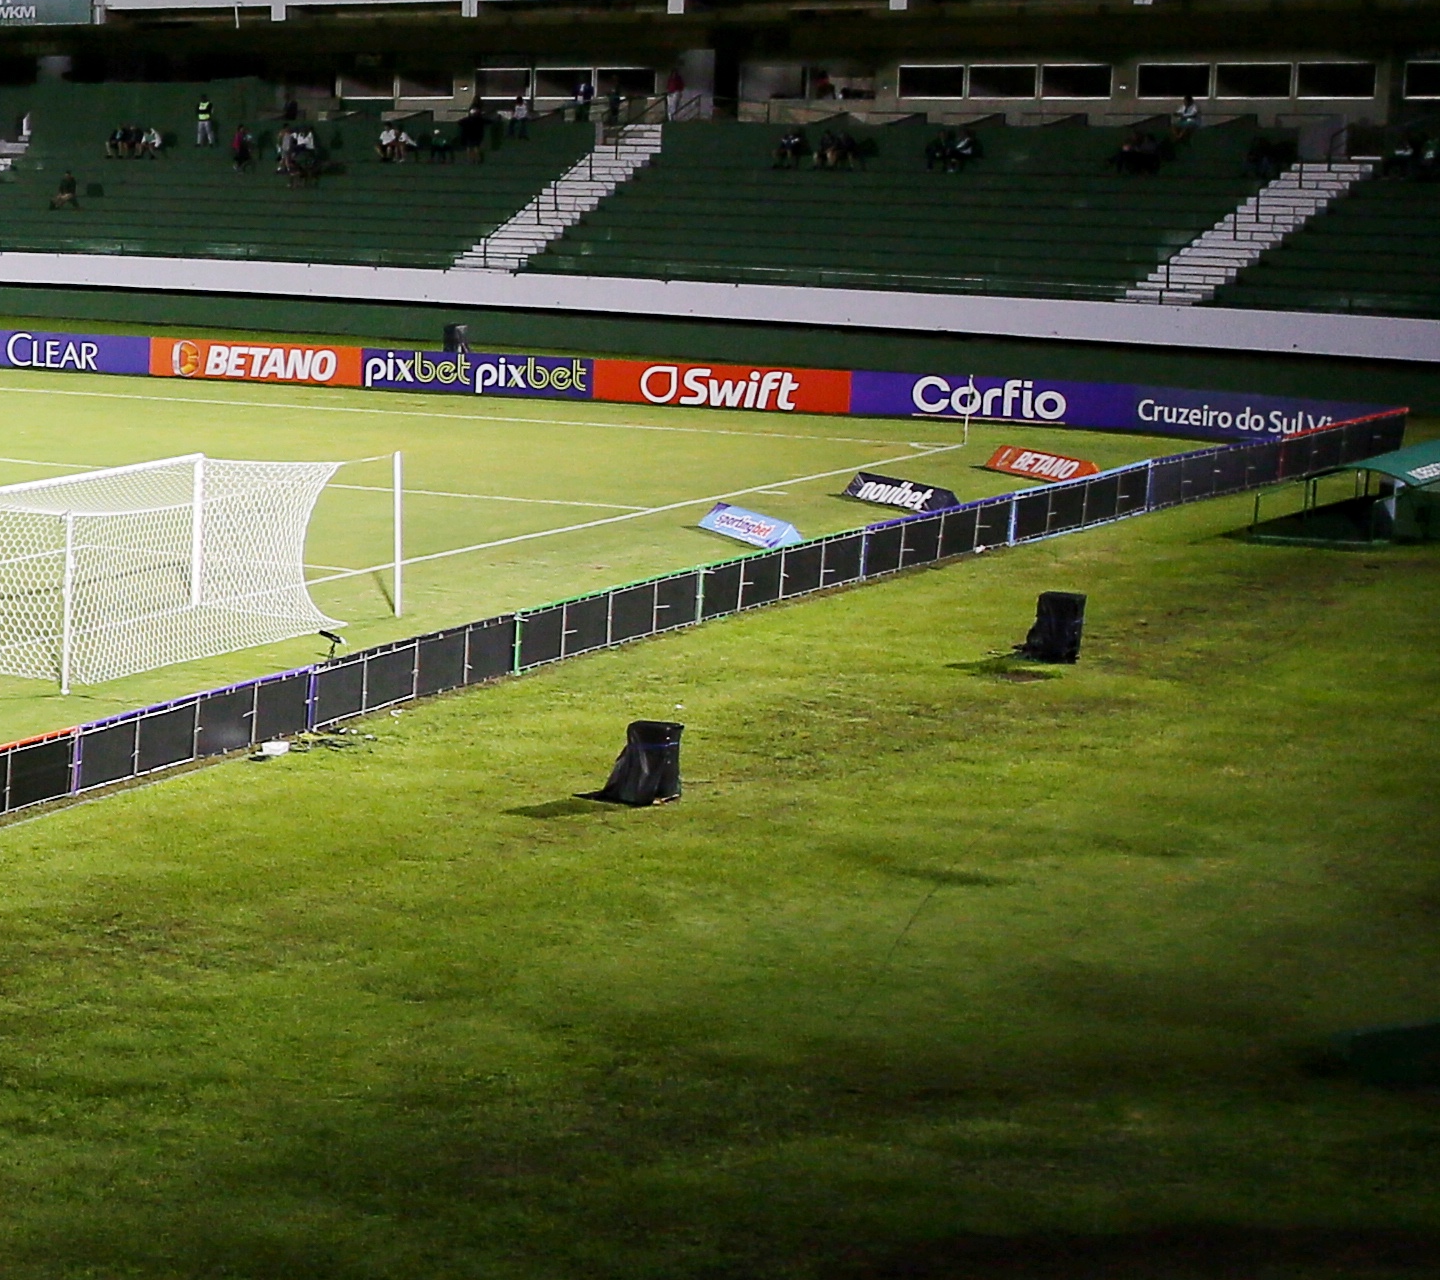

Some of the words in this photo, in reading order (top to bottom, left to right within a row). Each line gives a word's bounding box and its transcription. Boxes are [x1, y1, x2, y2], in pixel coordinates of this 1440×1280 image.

[6, 332, 98, 371] CLEAR
[205, 344, 337, 381] BETANO
[365, 351, 472, 388] pixbet
[475, 357, 587, 394] pixbet
[680, 368, 801, 411] Swift
[912, 376, 1068, 420] Corfio
[1137, 399, 1230, 428] Cruzeiro
[1235, 407, 1264, 431] do
[1268, 411, 1303, 433] Sul
[1014, 451, 1080, 480] BETANO
[858, 480, 935, 512] novibet
[715, 513, 773, 538] sportingbet
